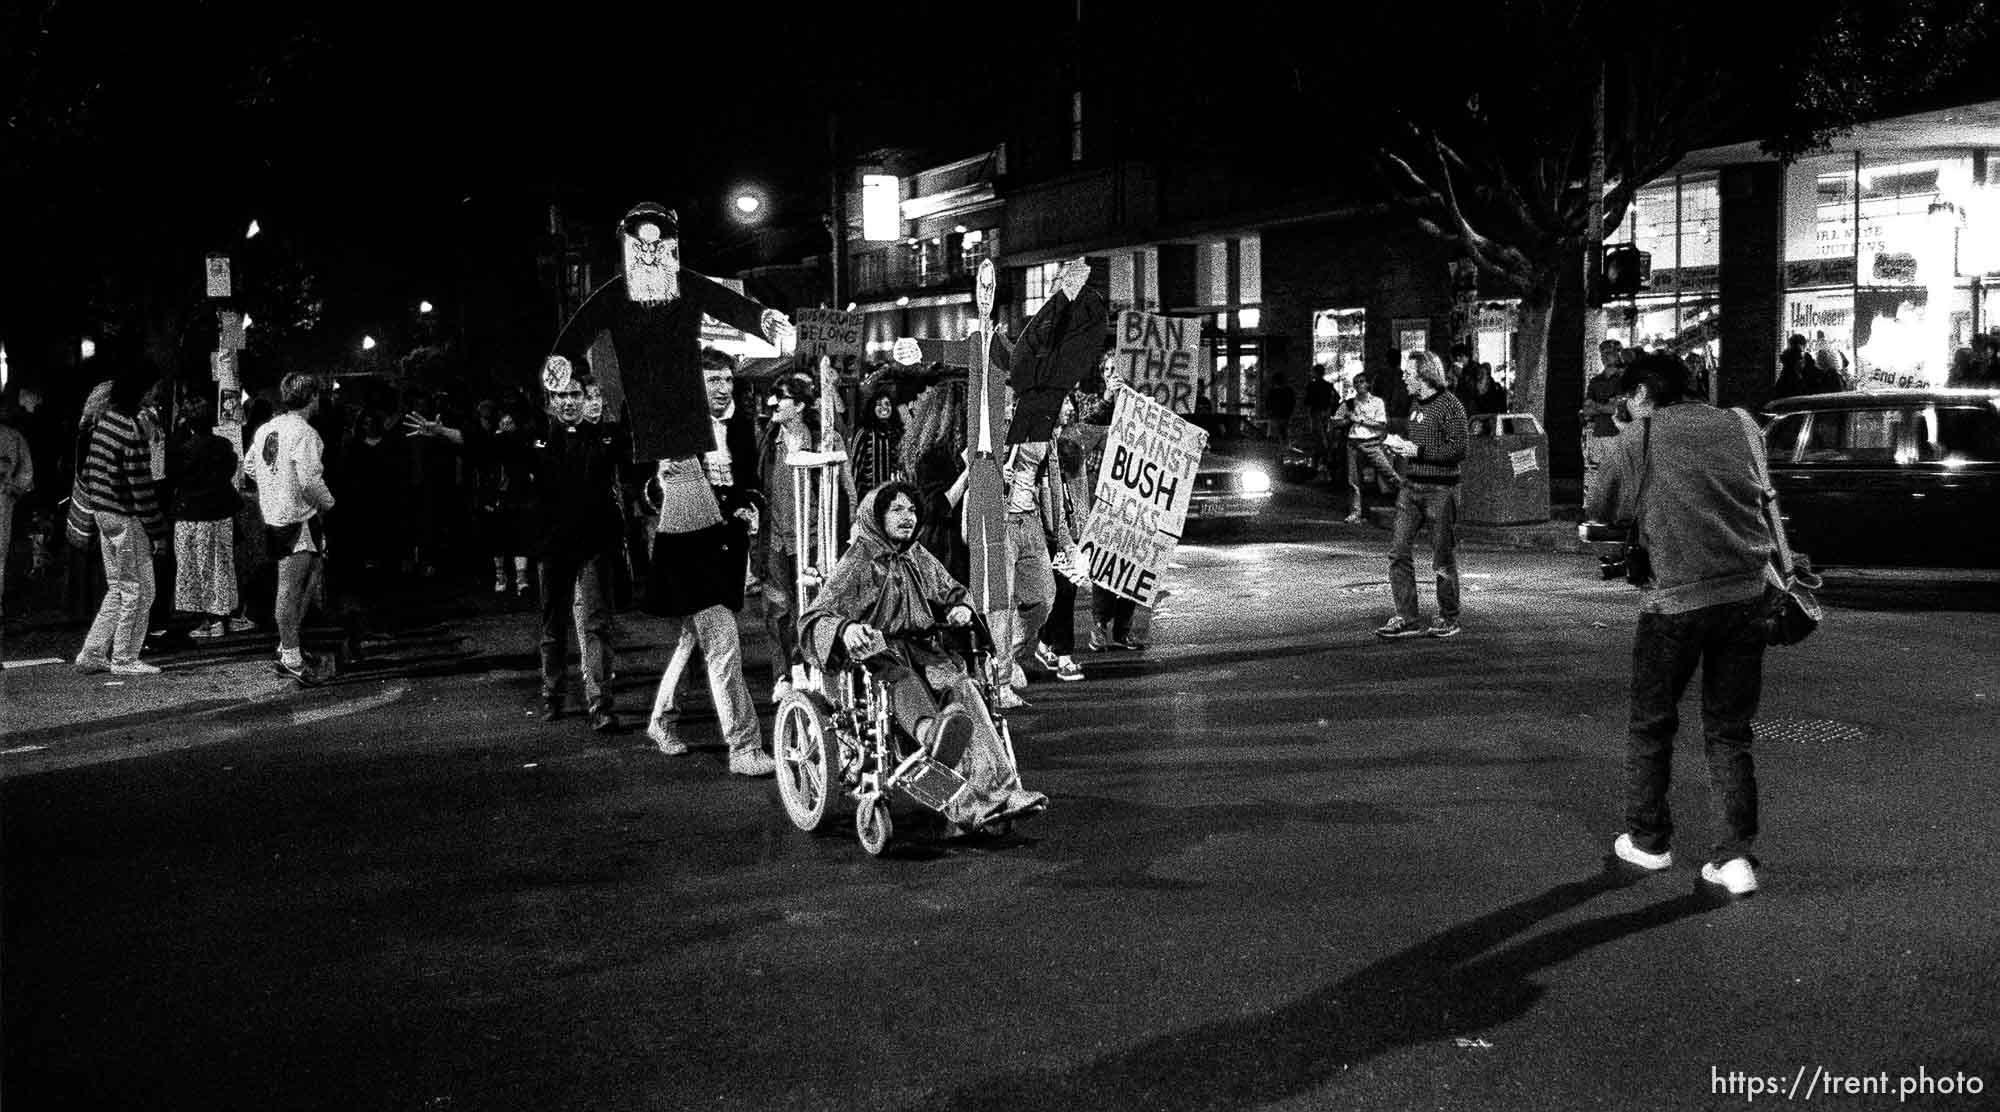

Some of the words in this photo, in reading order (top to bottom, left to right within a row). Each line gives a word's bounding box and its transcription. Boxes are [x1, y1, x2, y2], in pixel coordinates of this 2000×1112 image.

[800, 325, 858, 344] BELONG
[1125, 311, 1184, 351] BAN
[1790, 302, 1846, 328] Halloween
[1119, 347, 1191, 382] THE
[1871, 368, 1897, 385] End
[1899, 375, 1915, 389] of
[1121, 388, 1187, 443] TREES
[1125, 380, 1193, 415] OOR
[1110, 416, 1200, 480] AGAINST
[1110, 444, 1179, 512] BUSH
[1097, 481, 1161, 536] DUCKS
[1086, 516, 1168, 568] AGAINST
